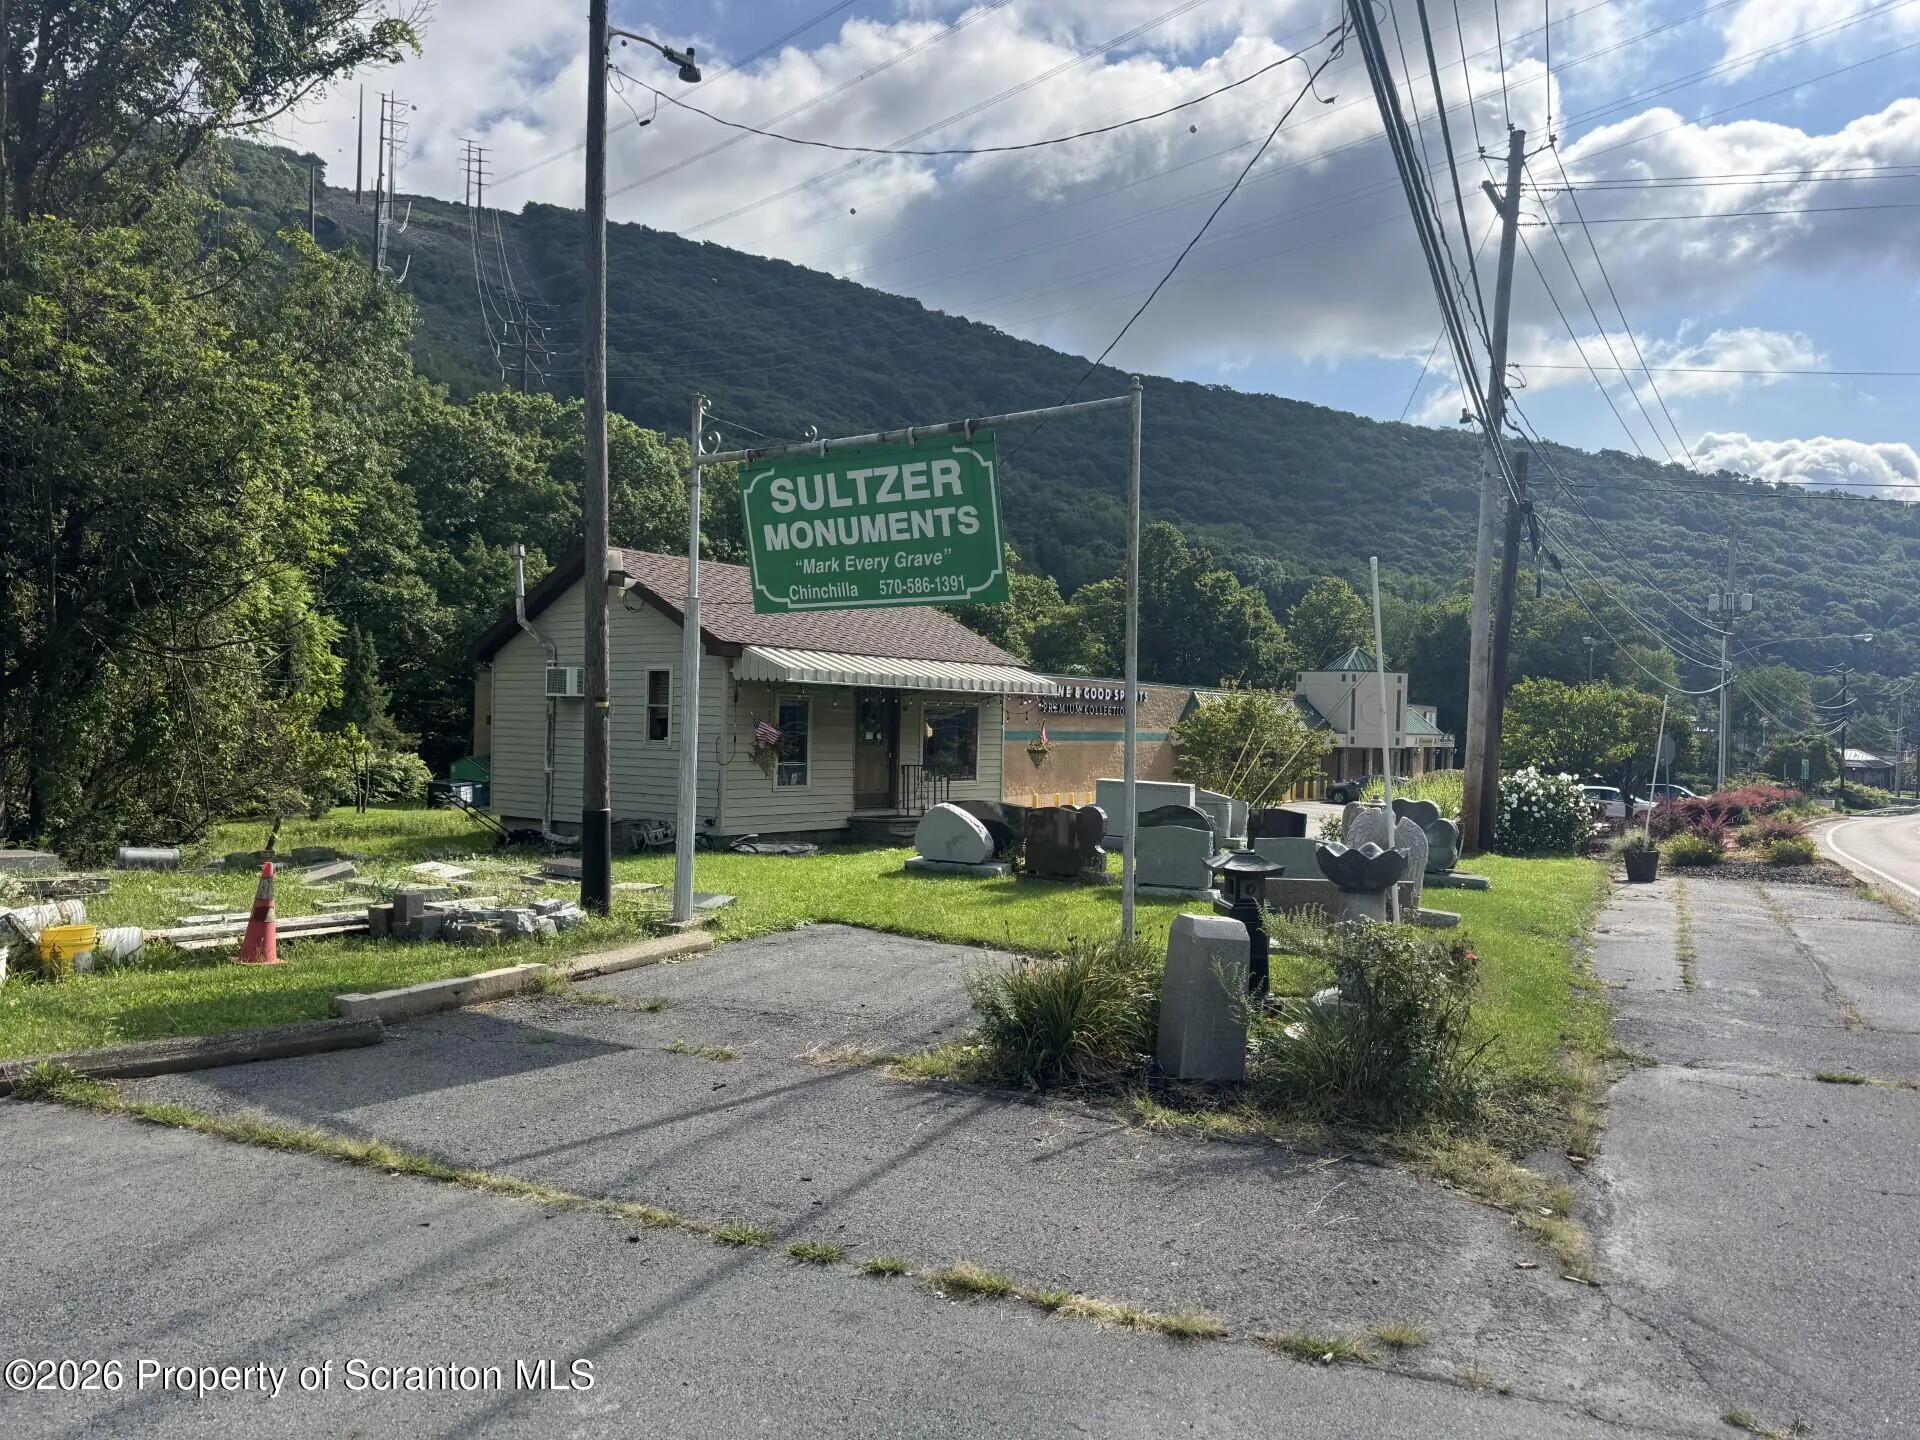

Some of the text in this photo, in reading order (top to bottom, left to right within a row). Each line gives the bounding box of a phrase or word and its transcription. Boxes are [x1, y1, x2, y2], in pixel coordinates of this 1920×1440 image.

[770, 458, 963, 514] SULTZER
[763, 505, 980, 551] MONUMENTS
[796, 548, 951, 574] “Mark Every Grave”
[789, 575, 965, 600] Chinchilla 570-586-1391
[1084, 687, 1111, 700] GOOD
[1043, 702, 1125, 717] PREMIUM COLLECTIO
